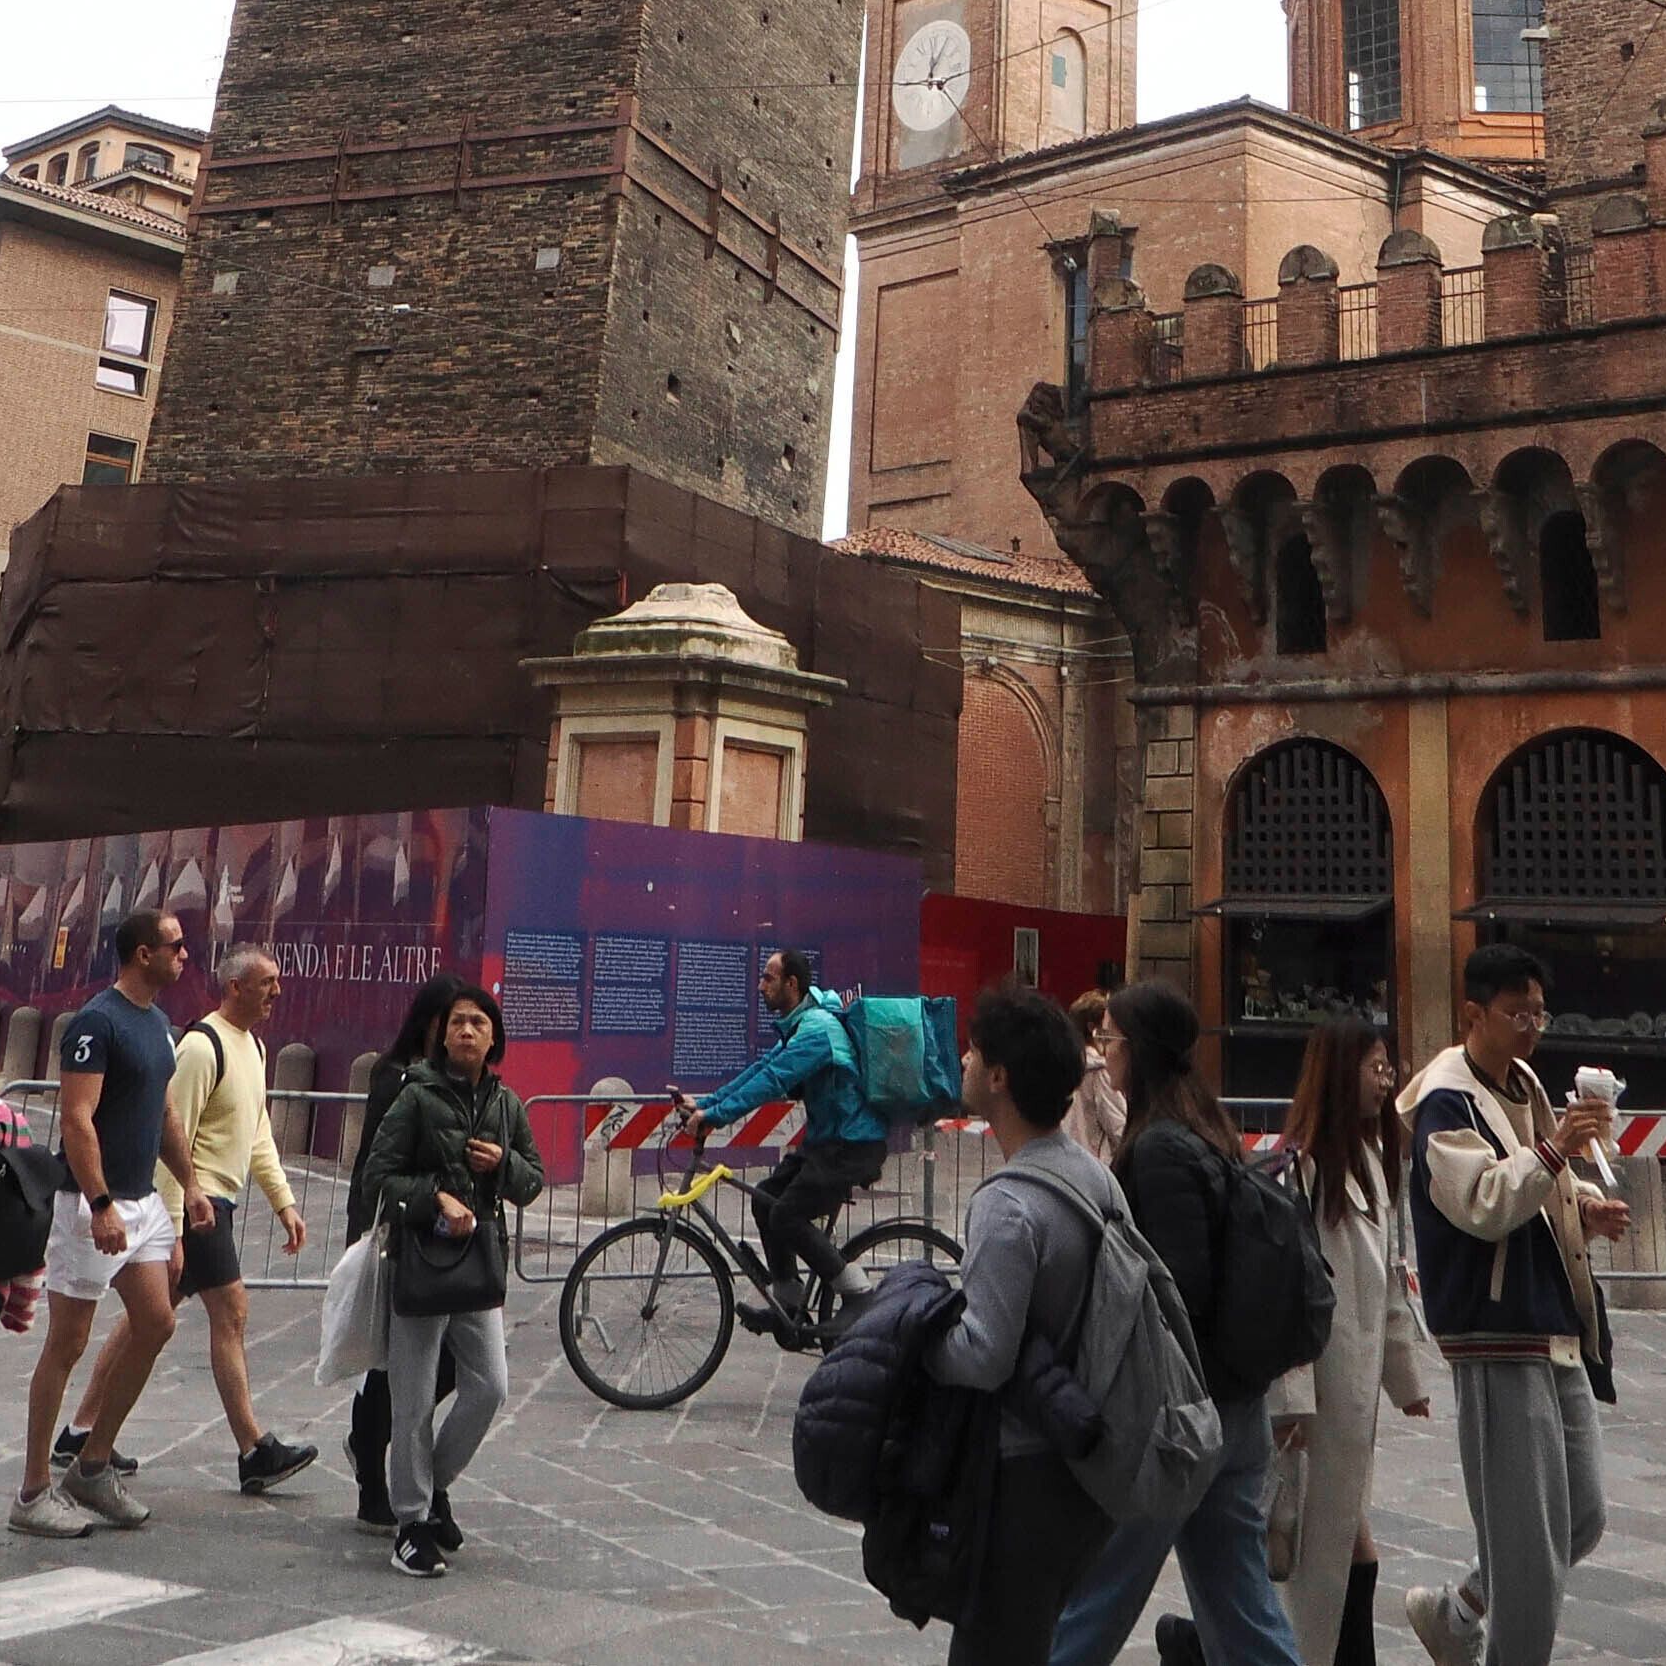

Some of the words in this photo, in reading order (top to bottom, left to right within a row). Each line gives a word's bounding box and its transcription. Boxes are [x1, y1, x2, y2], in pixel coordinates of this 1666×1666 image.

[334, 944, 345, 980] E
[349, 945, 373, 982] LE
[378, 946, 442, 984] ALTRE
[73, 1034, 93, 1063] 3
